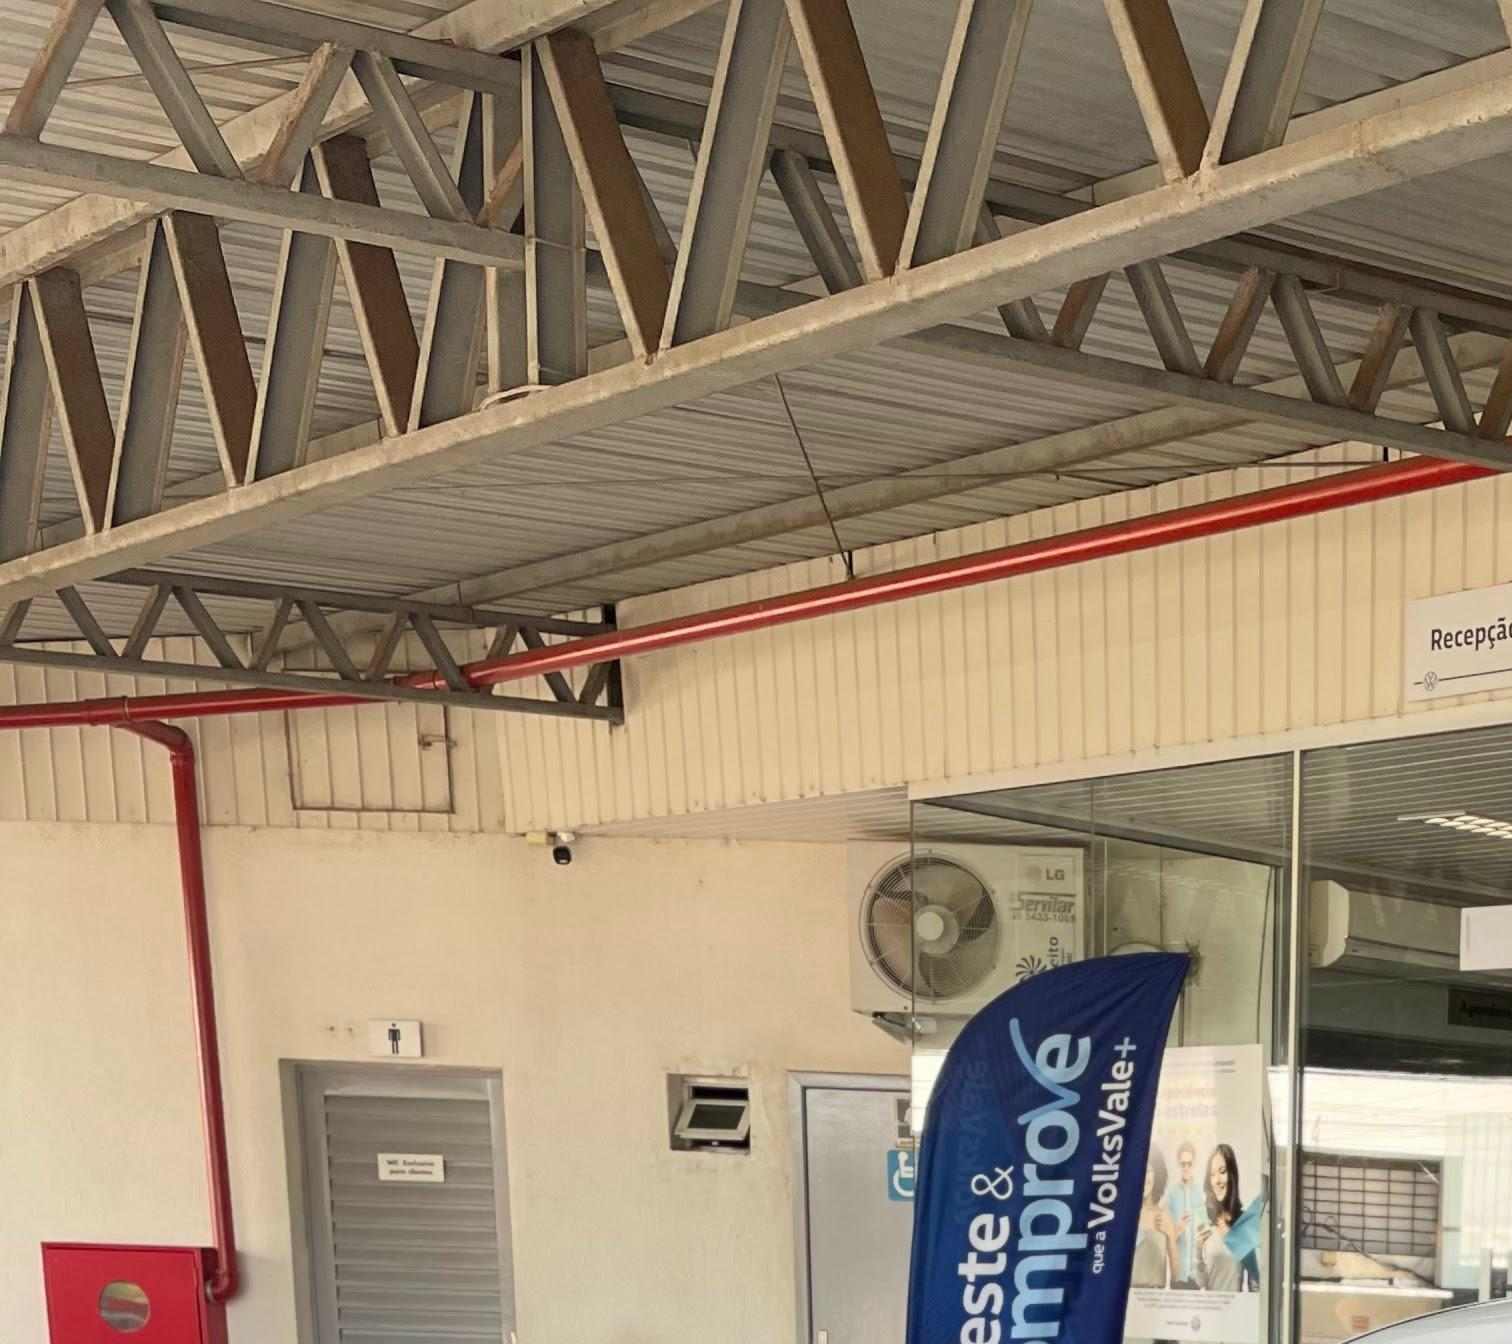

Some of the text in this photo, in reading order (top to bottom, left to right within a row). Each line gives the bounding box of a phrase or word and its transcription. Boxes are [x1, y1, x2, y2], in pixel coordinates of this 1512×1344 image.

[1045, 868, 1065, 881] LG
[1088, 1037, 1137, 1274] que a VolksVale+
[970, 1165, 1014, 1200] &
